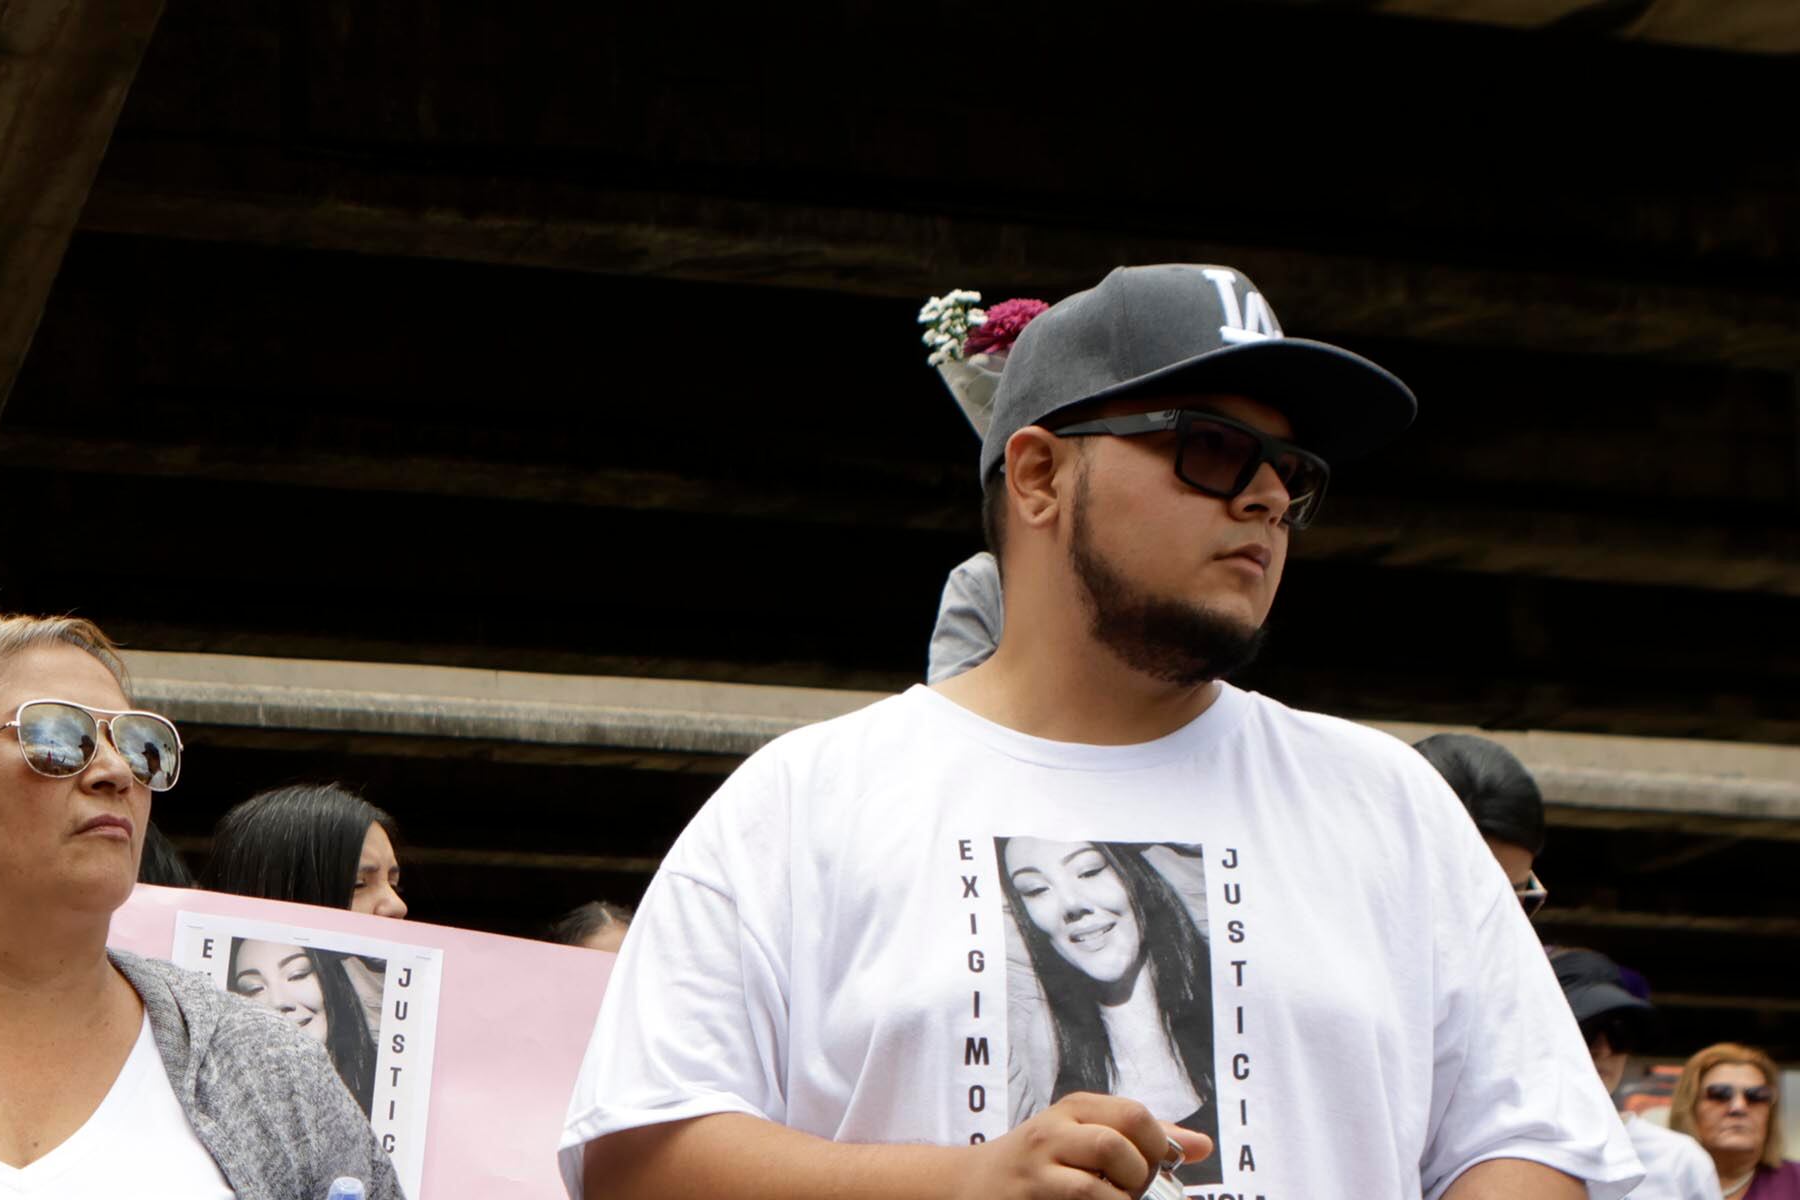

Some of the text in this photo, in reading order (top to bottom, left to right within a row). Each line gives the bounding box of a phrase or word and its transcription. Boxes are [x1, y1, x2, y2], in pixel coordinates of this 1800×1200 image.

[1203, 269, 1284, 342] LA
[382, 967, 412, 1154] JUSTIC
[1221, 848, 1257, 1173] JUSTICIA
